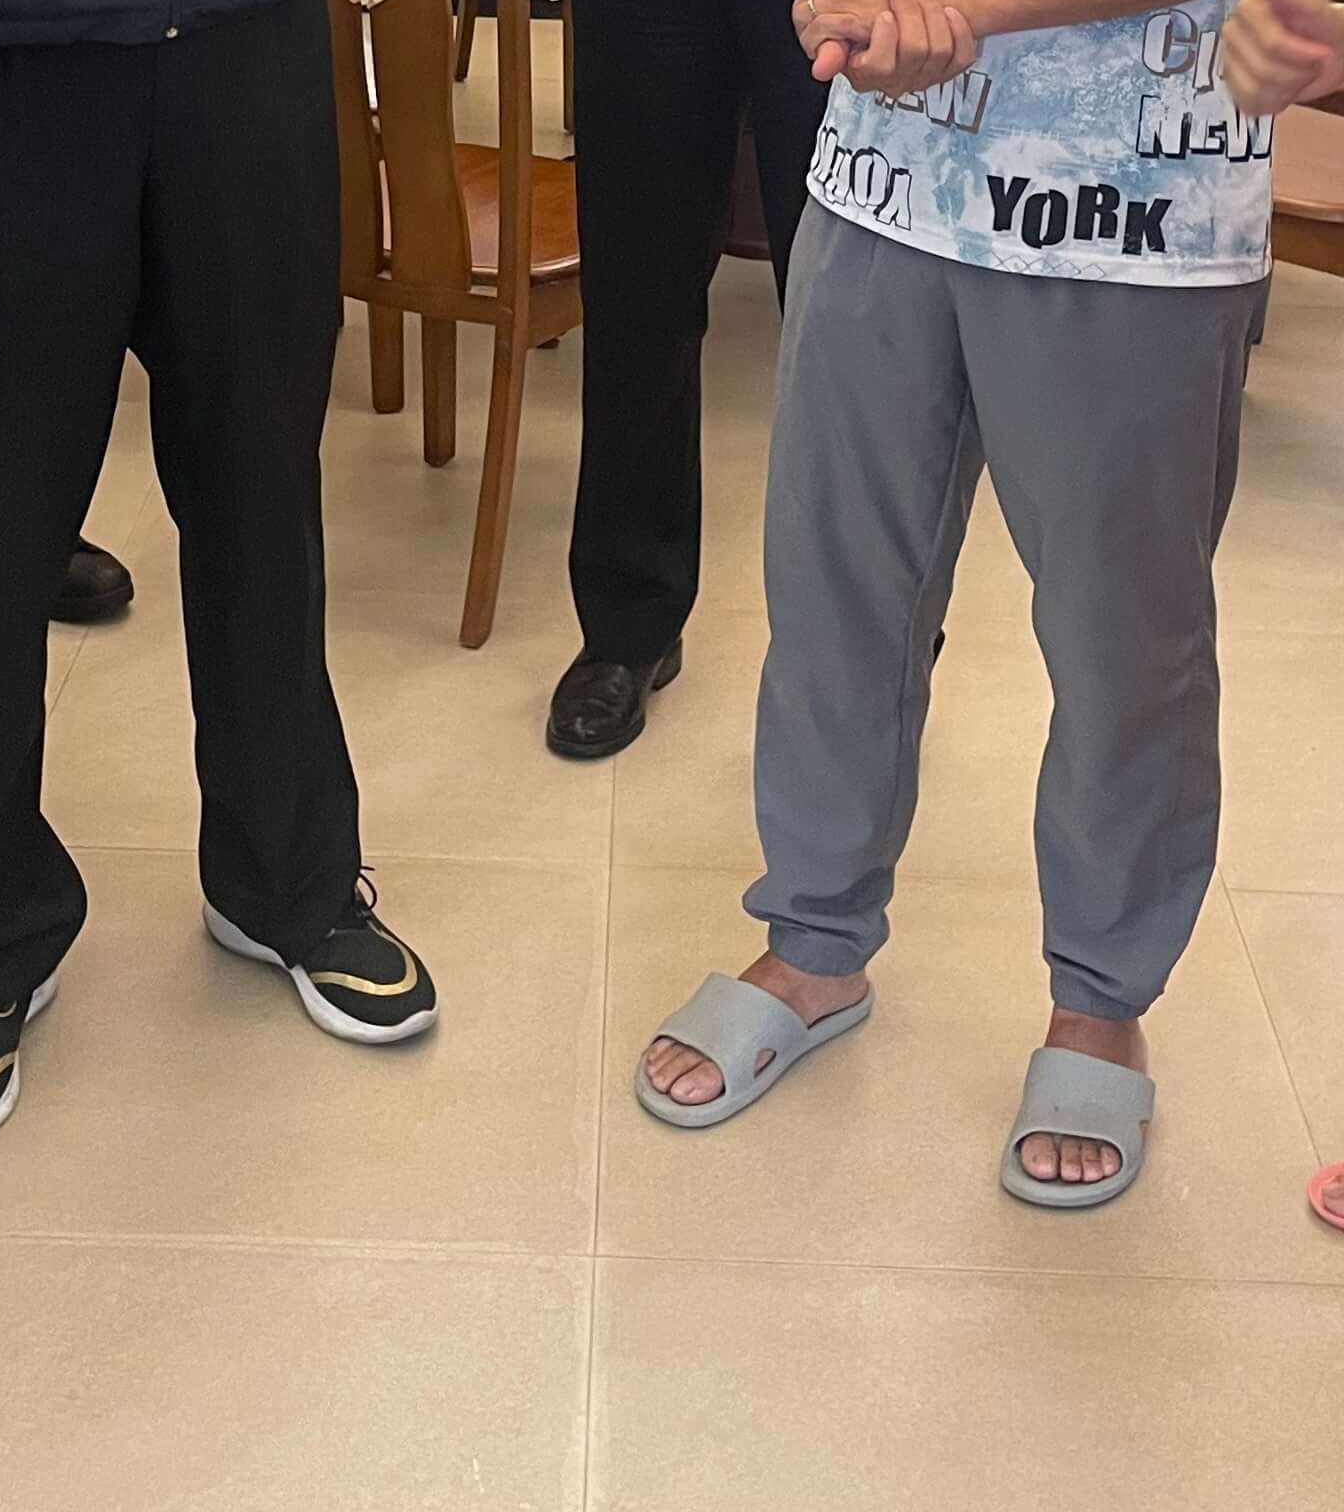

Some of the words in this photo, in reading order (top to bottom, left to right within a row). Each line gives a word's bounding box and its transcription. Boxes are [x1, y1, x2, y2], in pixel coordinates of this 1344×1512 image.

[1141, 8, 1224, 92] CI
[1135, 93, 1275, 163] NEW
[985, 175, 1174, 255] YORK
